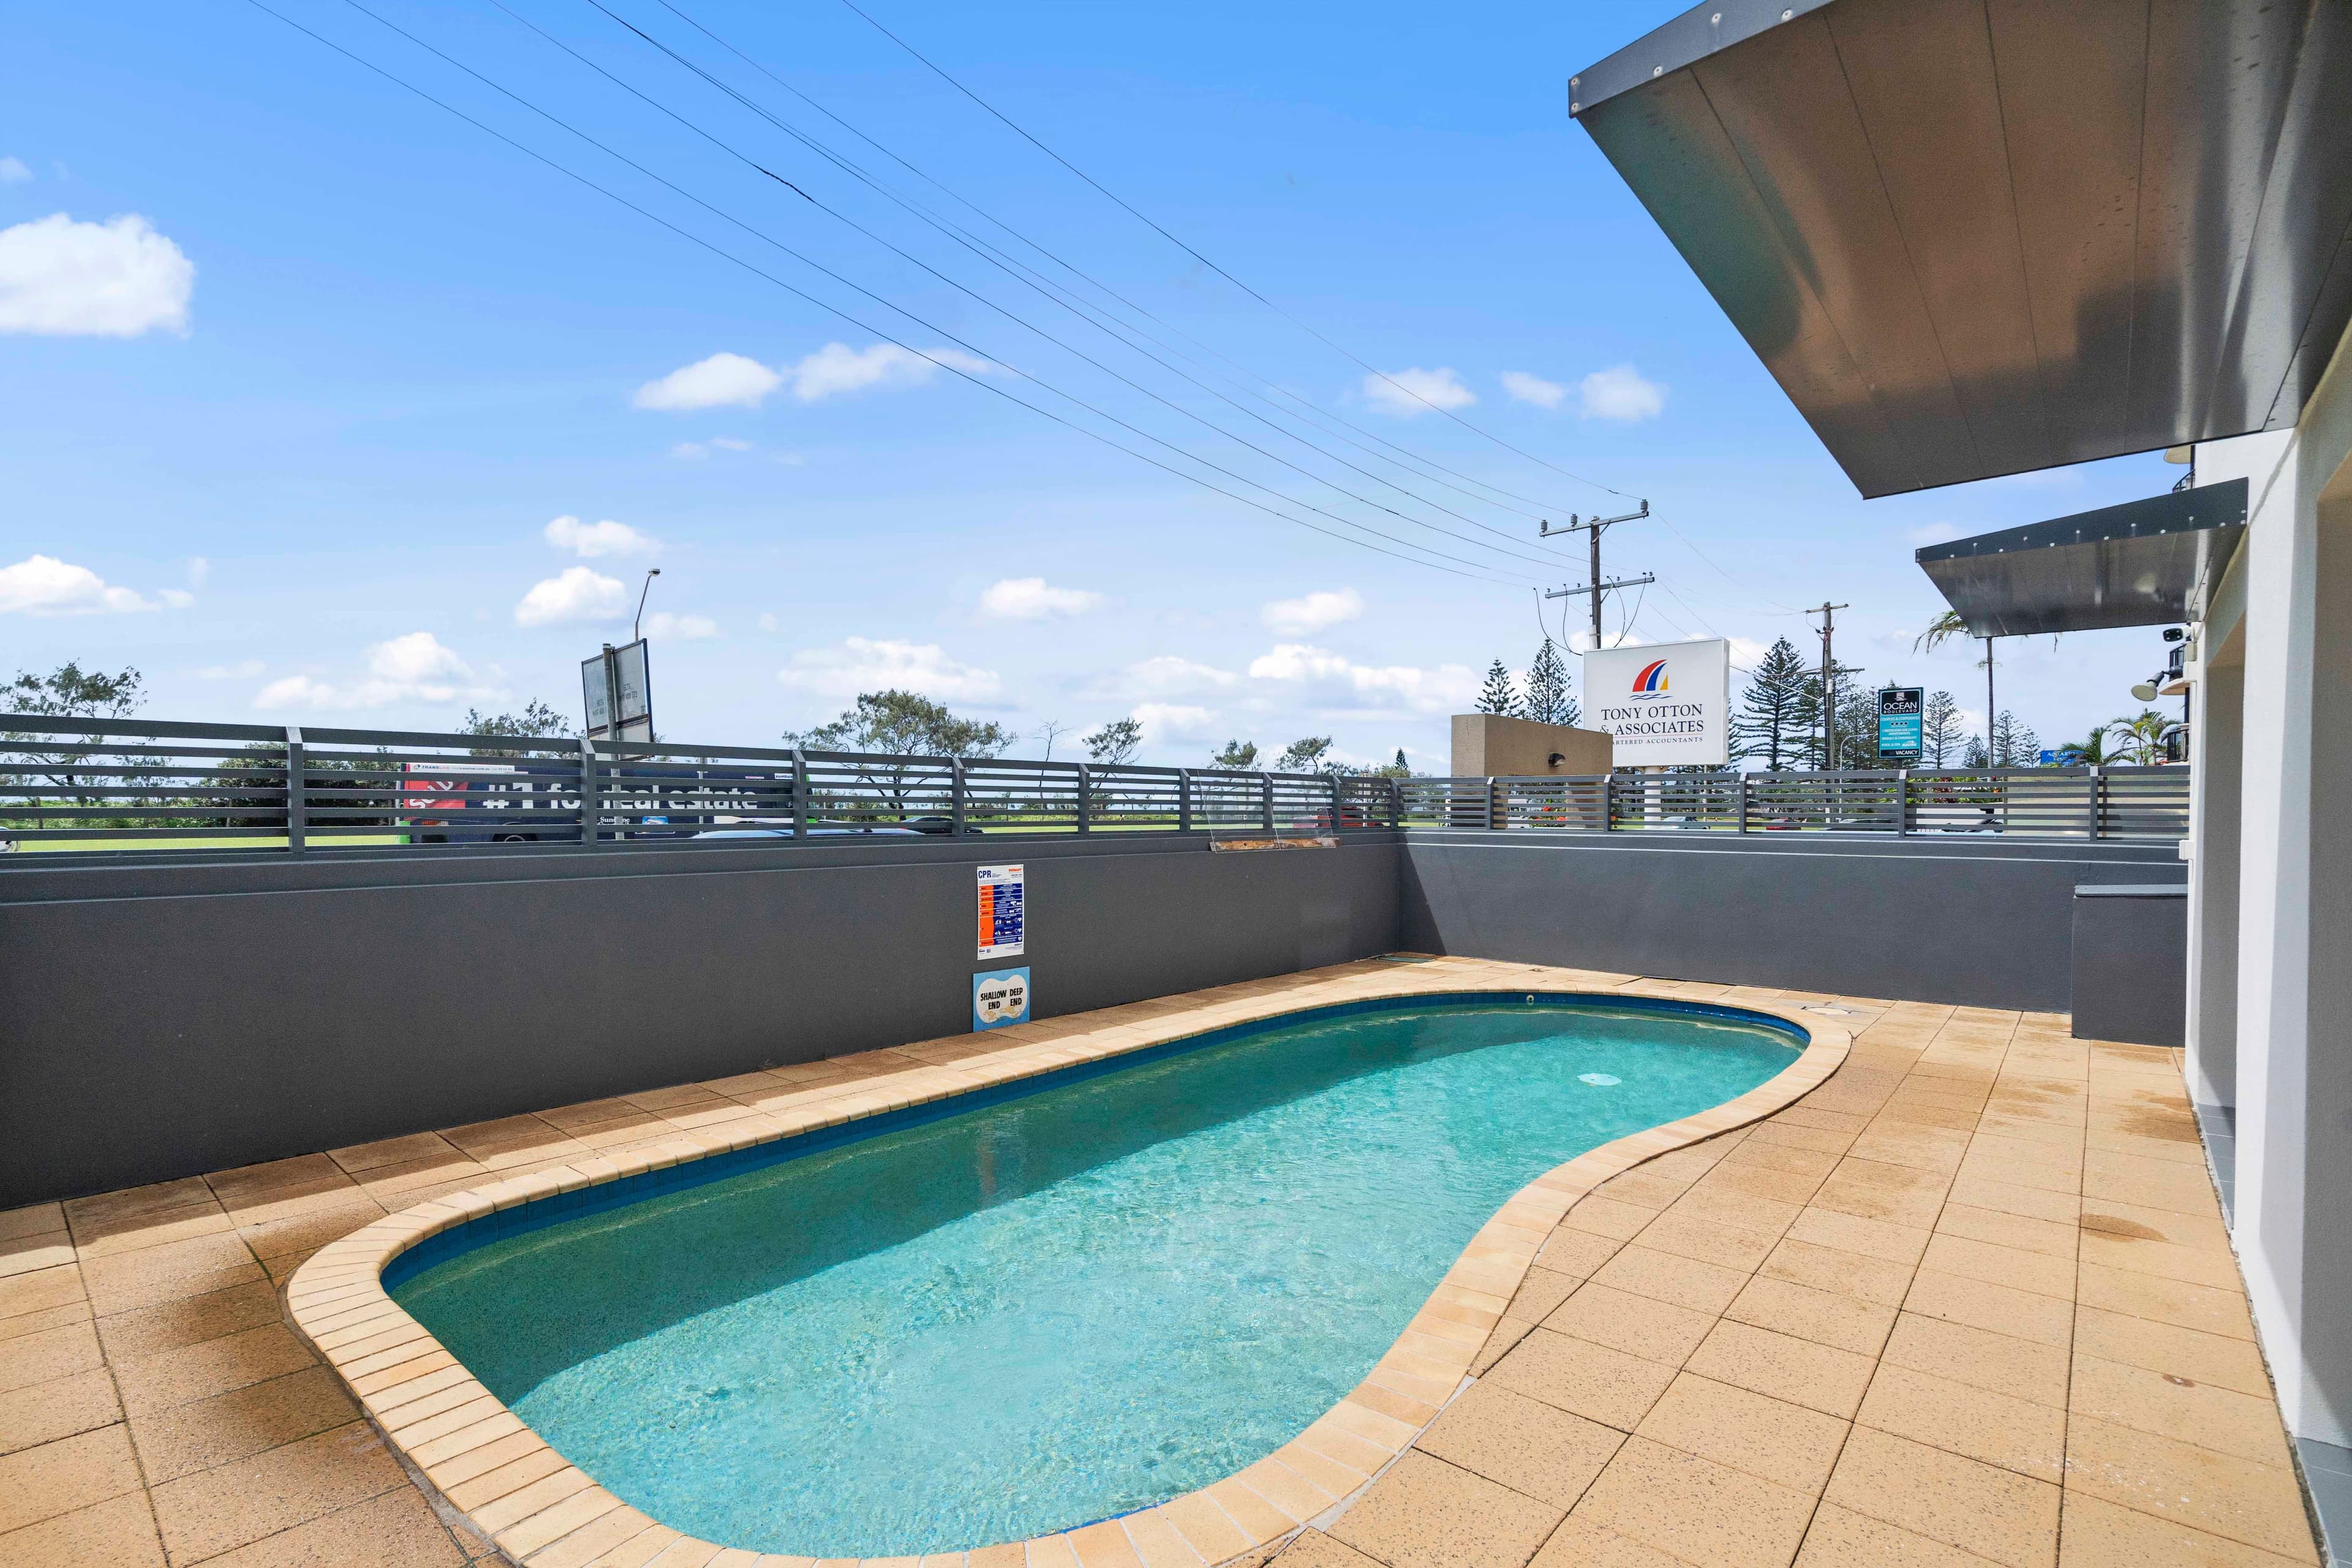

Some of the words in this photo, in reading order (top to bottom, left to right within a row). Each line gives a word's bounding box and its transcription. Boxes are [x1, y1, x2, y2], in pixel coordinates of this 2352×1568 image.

[1883, 701, 1917, 710] OCEAN
[1601, 707, 1642, 720] TONY
[1648, 704, 1703, 718] OTTON
[1600, 725, 1609, 734] &
[1615, 720, 1704, 736] ASSOCIATES
[483, 783, 534, 809] #1
[546, 783, 581, 809] fo
[668, 787, 758, 809] estate
[978, 870, 992, 878] CPR
[980, 989, 1007, 1001] SHALLOW
[1009, 987, 1023, 997] DEEP
[988, 1001, 1001, 1010] END
[1010, 997, 1022, 1006] END
